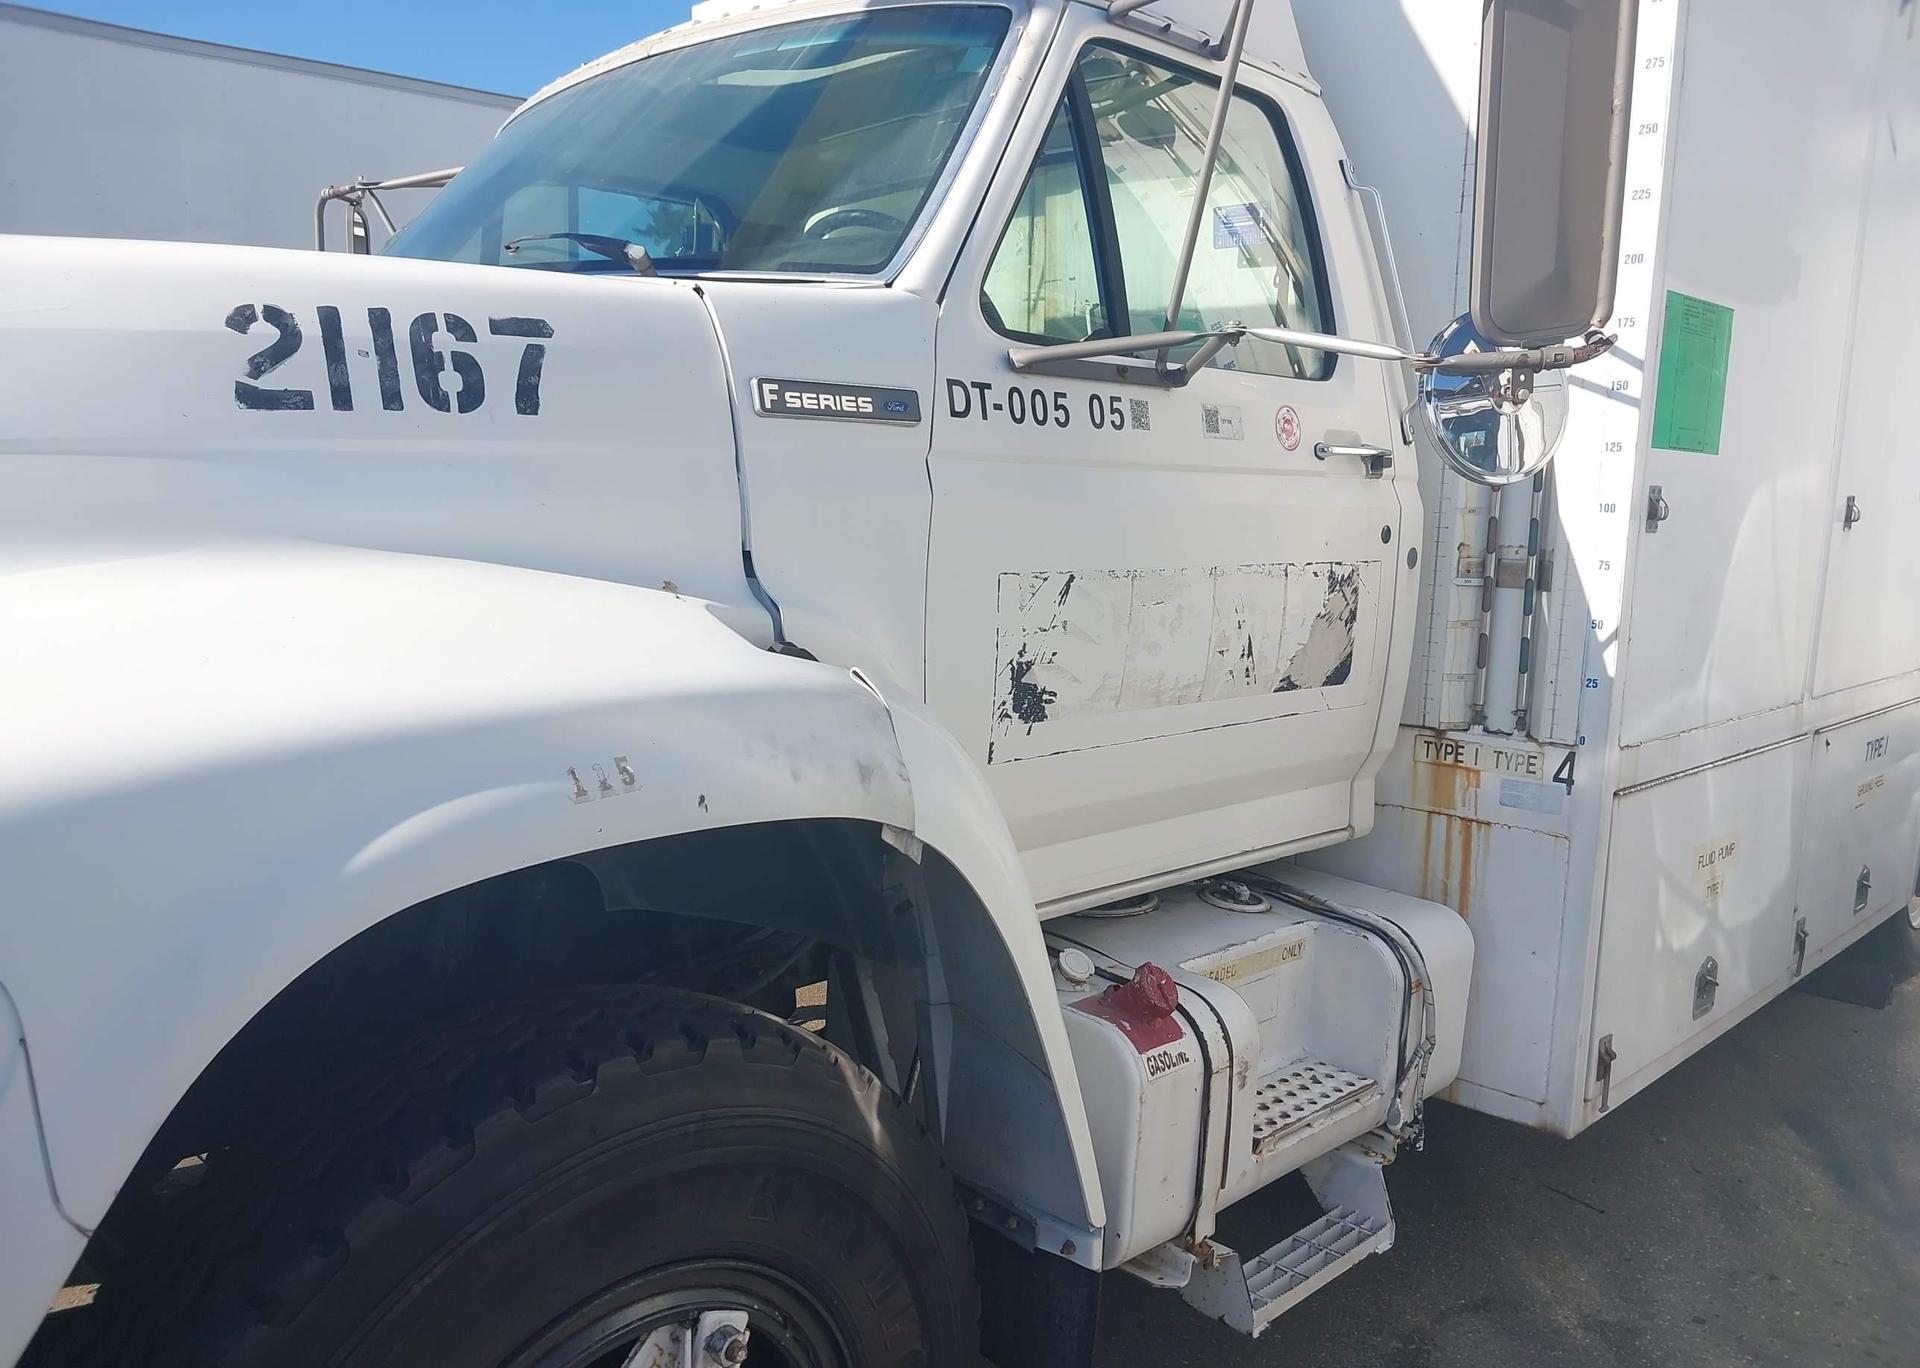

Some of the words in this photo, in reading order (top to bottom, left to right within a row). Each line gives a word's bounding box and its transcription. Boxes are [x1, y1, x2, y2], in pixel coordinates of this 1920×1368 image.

[1645, 57, 1665, 69] 275
[1638, 123, 1658, 135] 250
[1631, 189, 1651, 200] 225
[1624, 253, 1644, 264] 200
[1617, 317, 1636, 328] 175
[1610, 380, 1629, 392] 150
[762, 383, 779, 409] F
[784, 392, 874, 413] SERIES
[946, 378, 1072, 429] DT-005
[1088, 393, 1126, 431] 05
[1604, 442, 1622, 453] 125
[1598, 503, 1617, 514] 100
[1598, 560, 1611, 571] 75
[1591, 619, 1604, 630] 50
[1585, 678, 1598, 689] 25
[1865, 736, 1884, 762] TYPE
[1424, 740, 1466, 764] TYPE
[1493, 750, 1538, 775] TYPE
[1552, 751, 1577, 796] 4
[1698, 850, 1716, 870] FLUID
[1717, 843, 1736, 862] PUMP
[1281, 941, 1304, 961] ONLY
